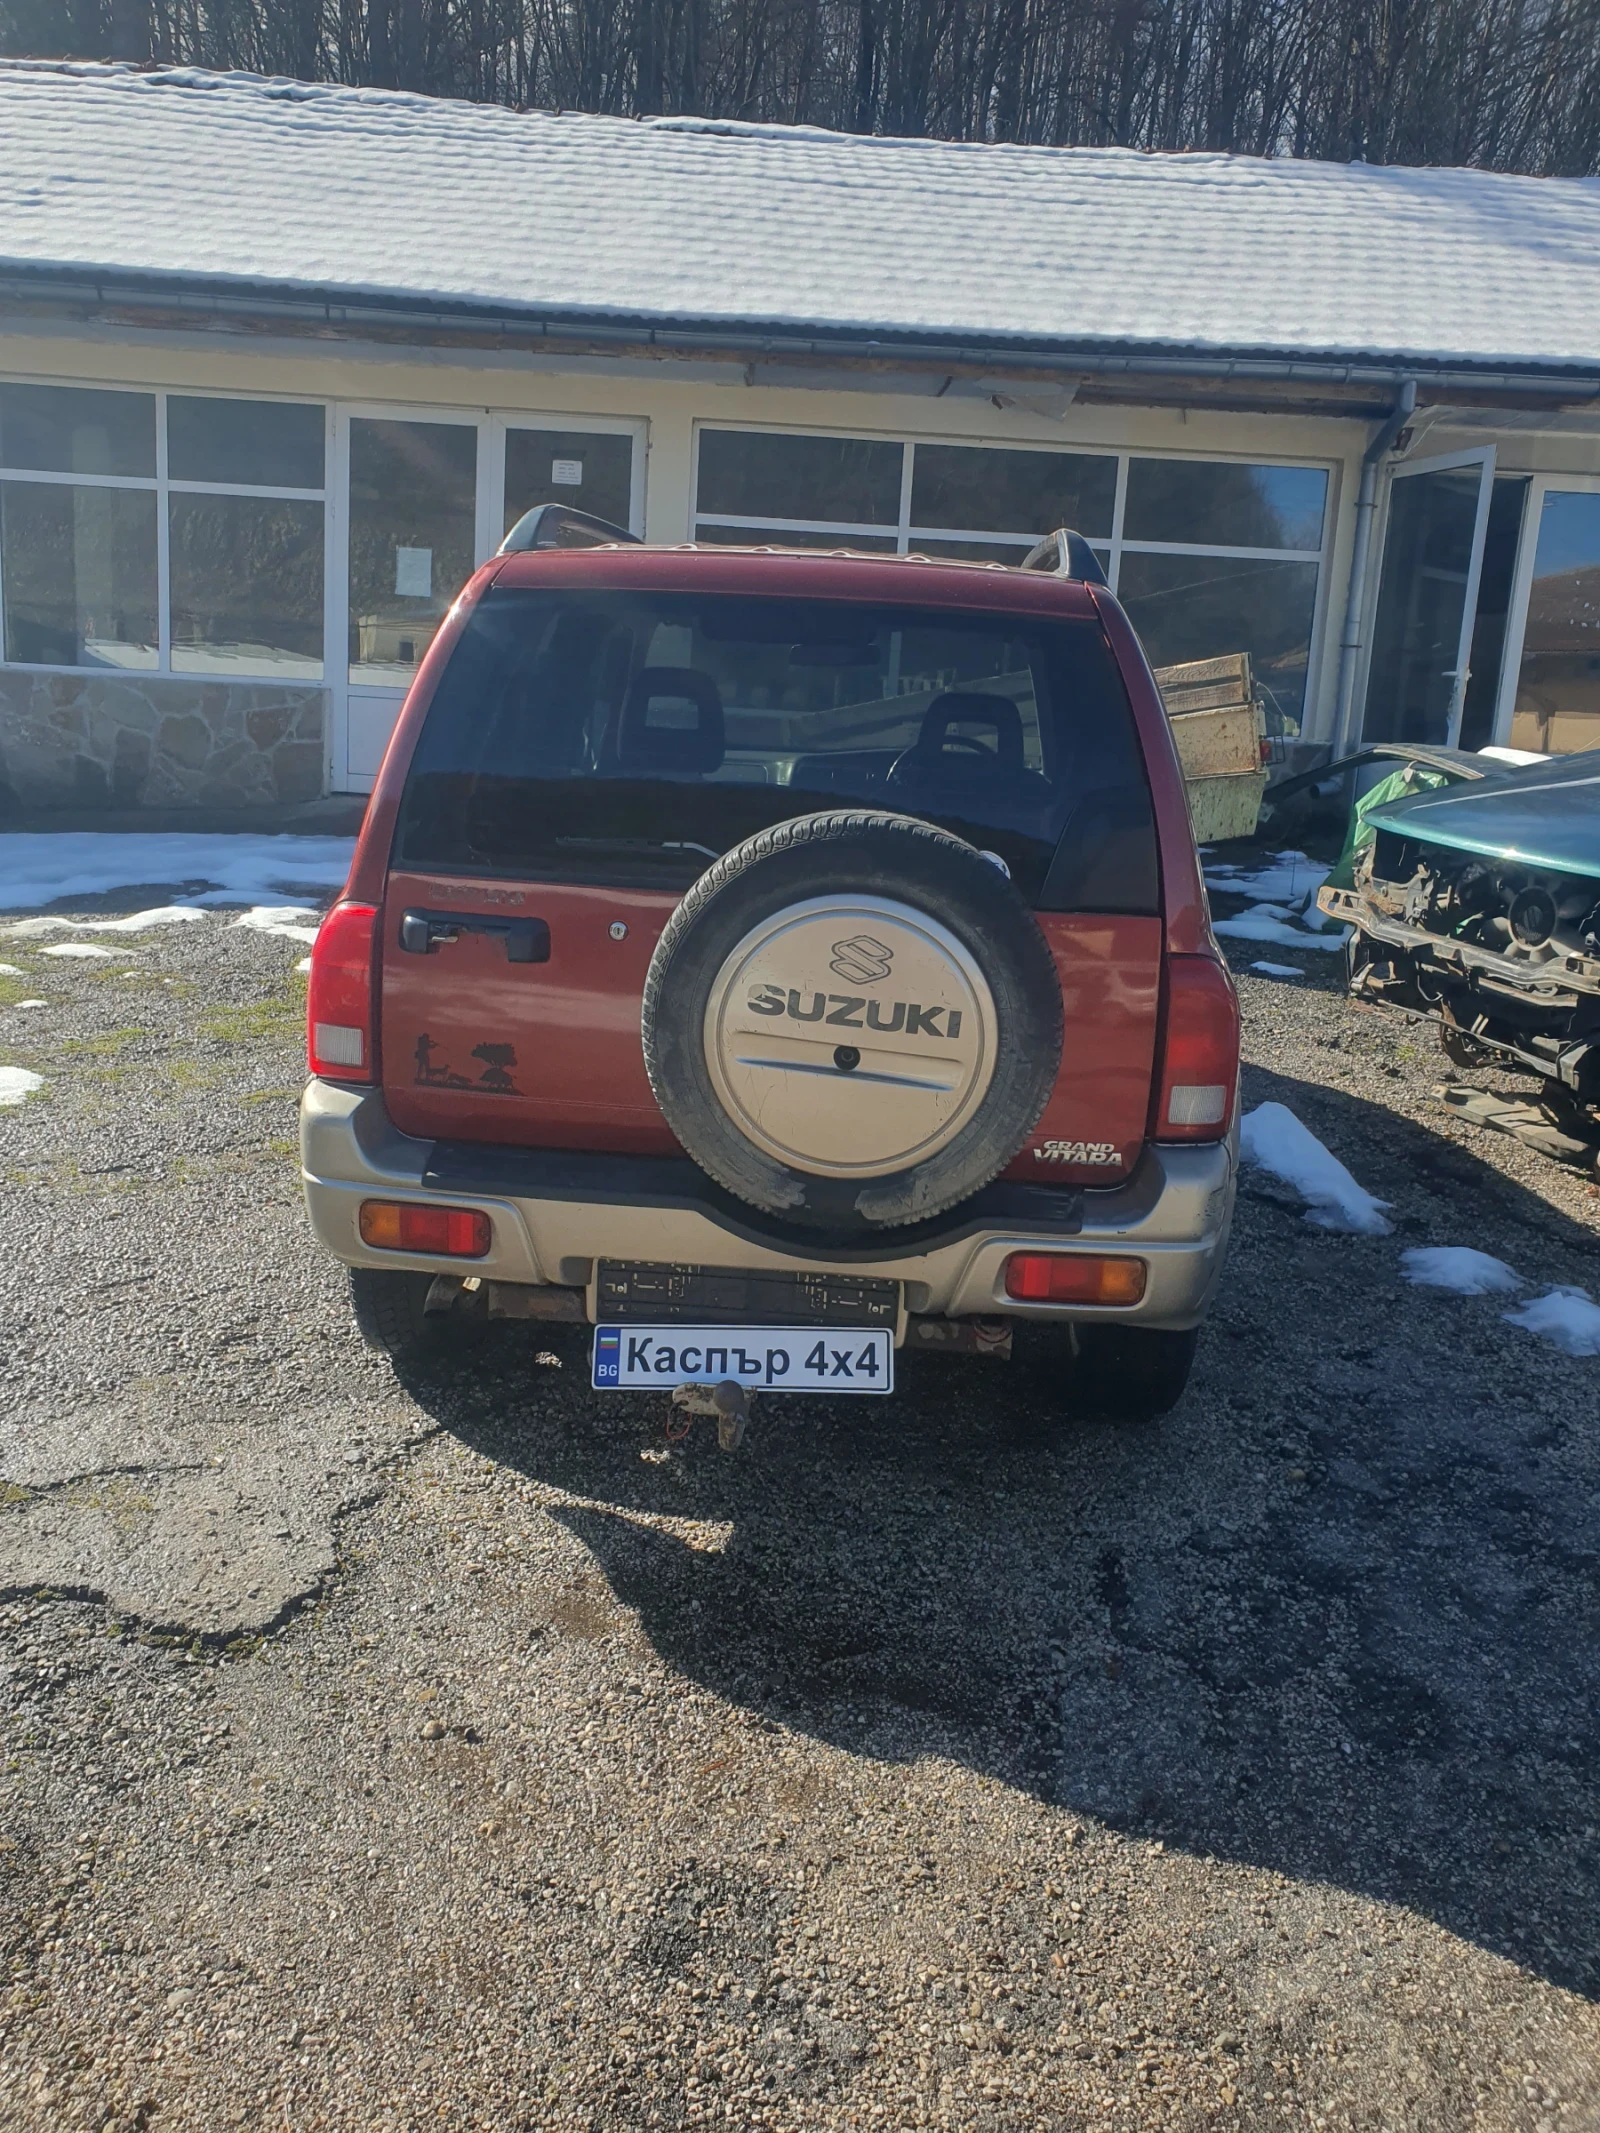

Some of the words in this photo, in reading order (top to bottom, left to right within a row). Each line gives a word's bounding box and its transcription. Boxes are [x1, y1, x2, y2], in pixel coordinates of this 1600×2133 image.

[747, 984, 962, 1039] SUZUKI
[1043, 1140, 1115, 1153] GRAND
[1033, 1148, 1122, 1166] VITARA
[626, 1337, 791, 1384] Каспър
[598, 1364, 618, 1377] BG
